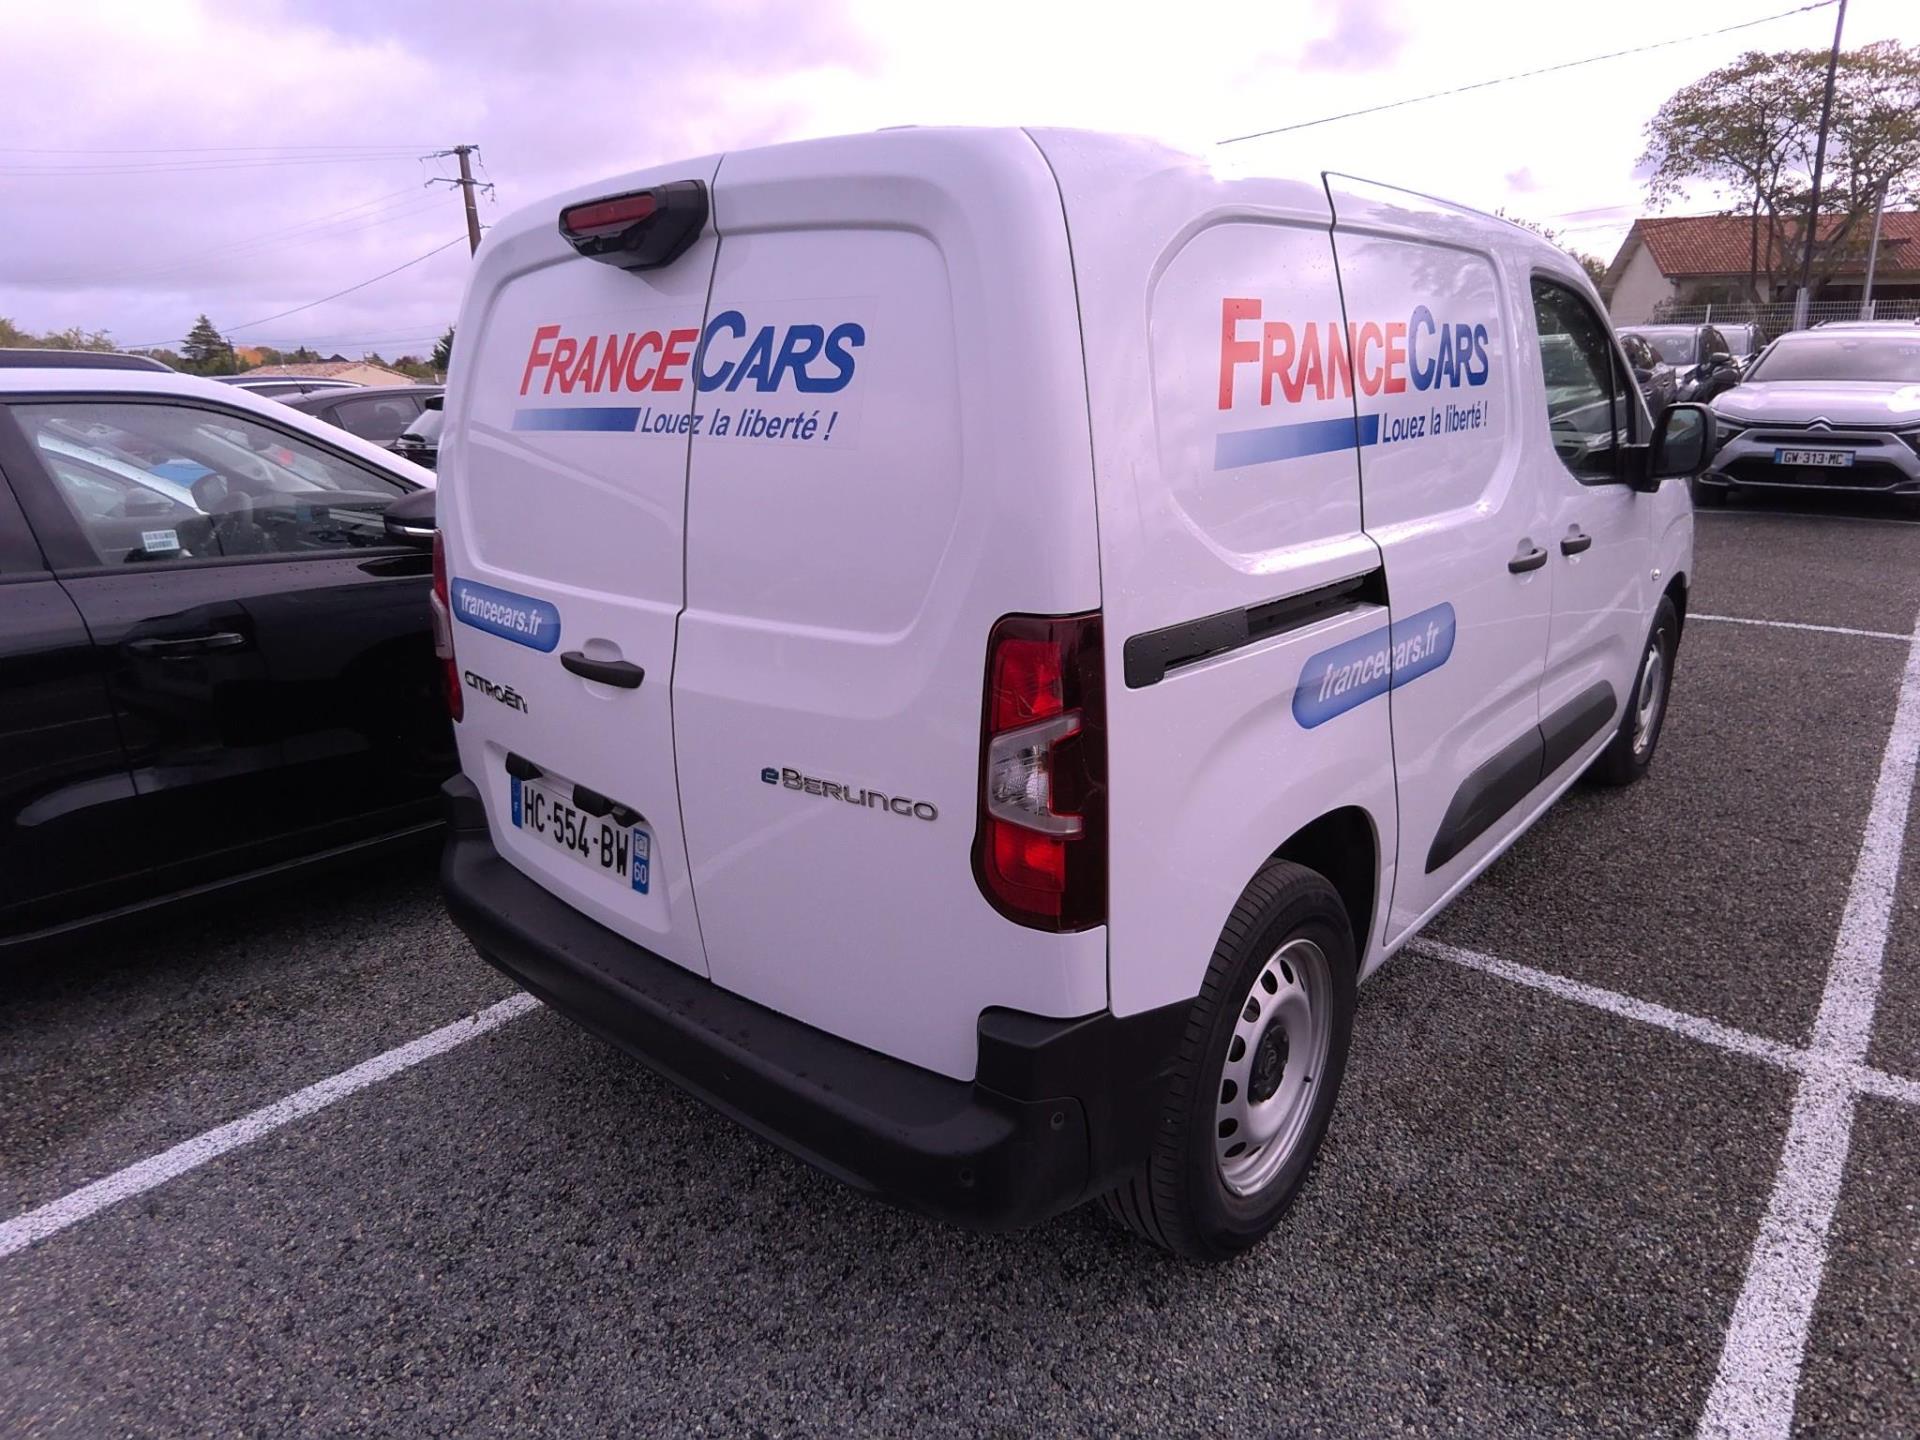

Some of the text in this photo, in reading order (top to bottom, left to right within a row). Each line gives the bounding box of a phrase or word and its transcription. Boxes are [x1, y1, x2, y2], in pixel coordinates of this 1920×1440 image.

[641, 407, 704, 435] Louez
[708, 408, 731, 436] la
[735, 408, 820, 441] liberté
[1382, 412, 1426, 443] Louez
[1430, 406, 1441, 435] la
[1784, 452, 1844, 465] GW-313-MC
[460, 588, 543, 636] francecars.fr
[1318, 621, 1440, 703] francecars.fr
[524, 785, 629, 877] HC-554-BW
[634, 861, 647, 884] 60
